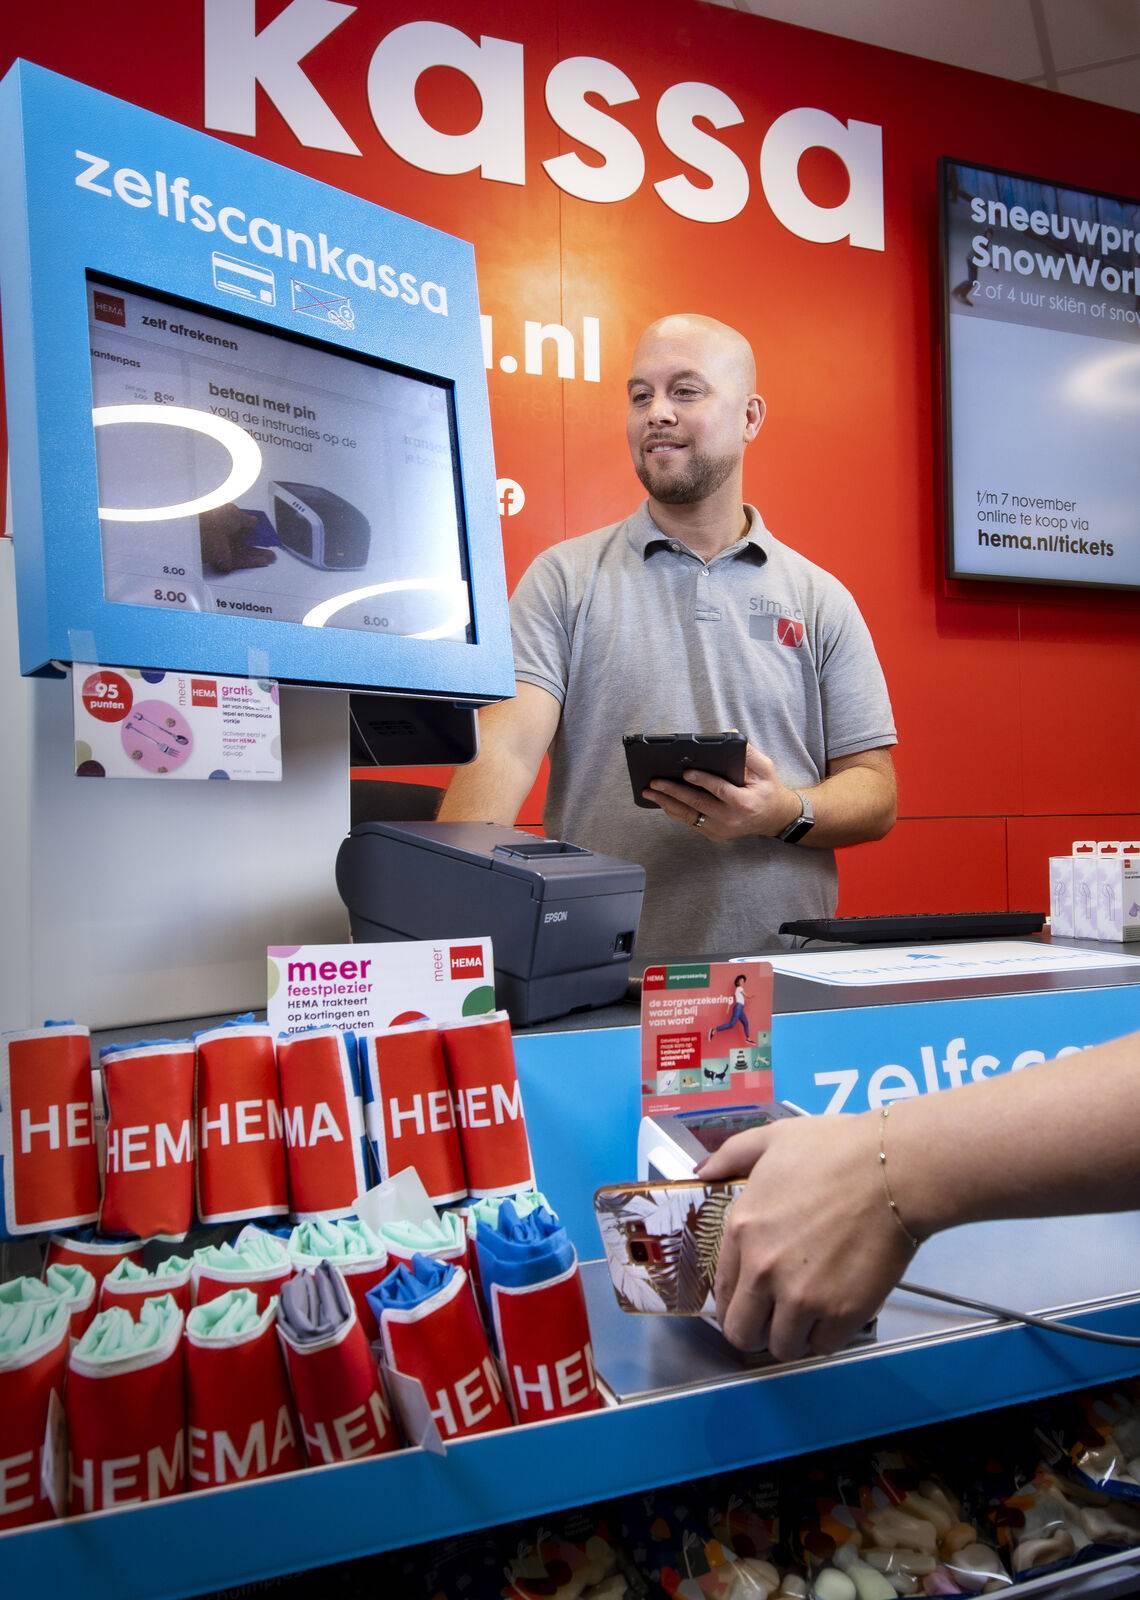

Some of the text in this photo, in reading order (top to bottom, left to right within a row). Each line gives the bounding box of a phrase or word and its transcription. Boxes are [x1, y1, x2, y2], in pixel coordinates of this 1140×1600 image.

[204, 0, 885, 252] kassa
[75, 149, 449, 317] zelfscankassa
[972, 280, 982, 297] 2
[985, 284, 1003, 300] of
[1007, 290, 1017, 302] 4
[1021, 292, 1046, 308] uur
[1049, 296, 1087, 315] skiën
[1090, 303, 1107, 319] of
[95, 302, 124, 316] HEMA
[142, 316, 240, 351] zelf afrekenen
[208, 382, 316, 421] betaal met pin
[210, 404, 358, 449] volg de instructies op de
[976, 490, 1077, 512] t/m 7 november
[977, 509, 1089, 531] online te koop via
[978, 529, 1114, 557] hema.nl/tickets
[162, 565, 186, 577] 8.00
[153, 588, 187, 603] 8.00
[216, 598, 273, 614] te voldoen
[749, 594, 803, 620] simac
[363, 615, 390, 628] 8.00
[178, 679, 186, 706] meer
[192, 688, 217, 698] HEMA
[221, 685, 254, 696] gratis
[90, 700, 125, 709] punten
[544, 911, 569, 923] EPSON
[287, 959, 372, 982] meer
[433, 947, 444, 982] meer
[451, 957, 483, 968] HEMA
[646, 974, 665, 982] HEMA
[287, 981, 374, 998] feestplezier
[287, 996, 368, 1009] HEMA trakteert
[649, 995, 734, 1008] de zorgverzekering
[287, 1009, 370, 1022] op kortingen en
[648, 1006, 698, 1018] waar je blij
[389, 1089, 456, 1139] HE
[20, 1102, 96, 1154] HE
